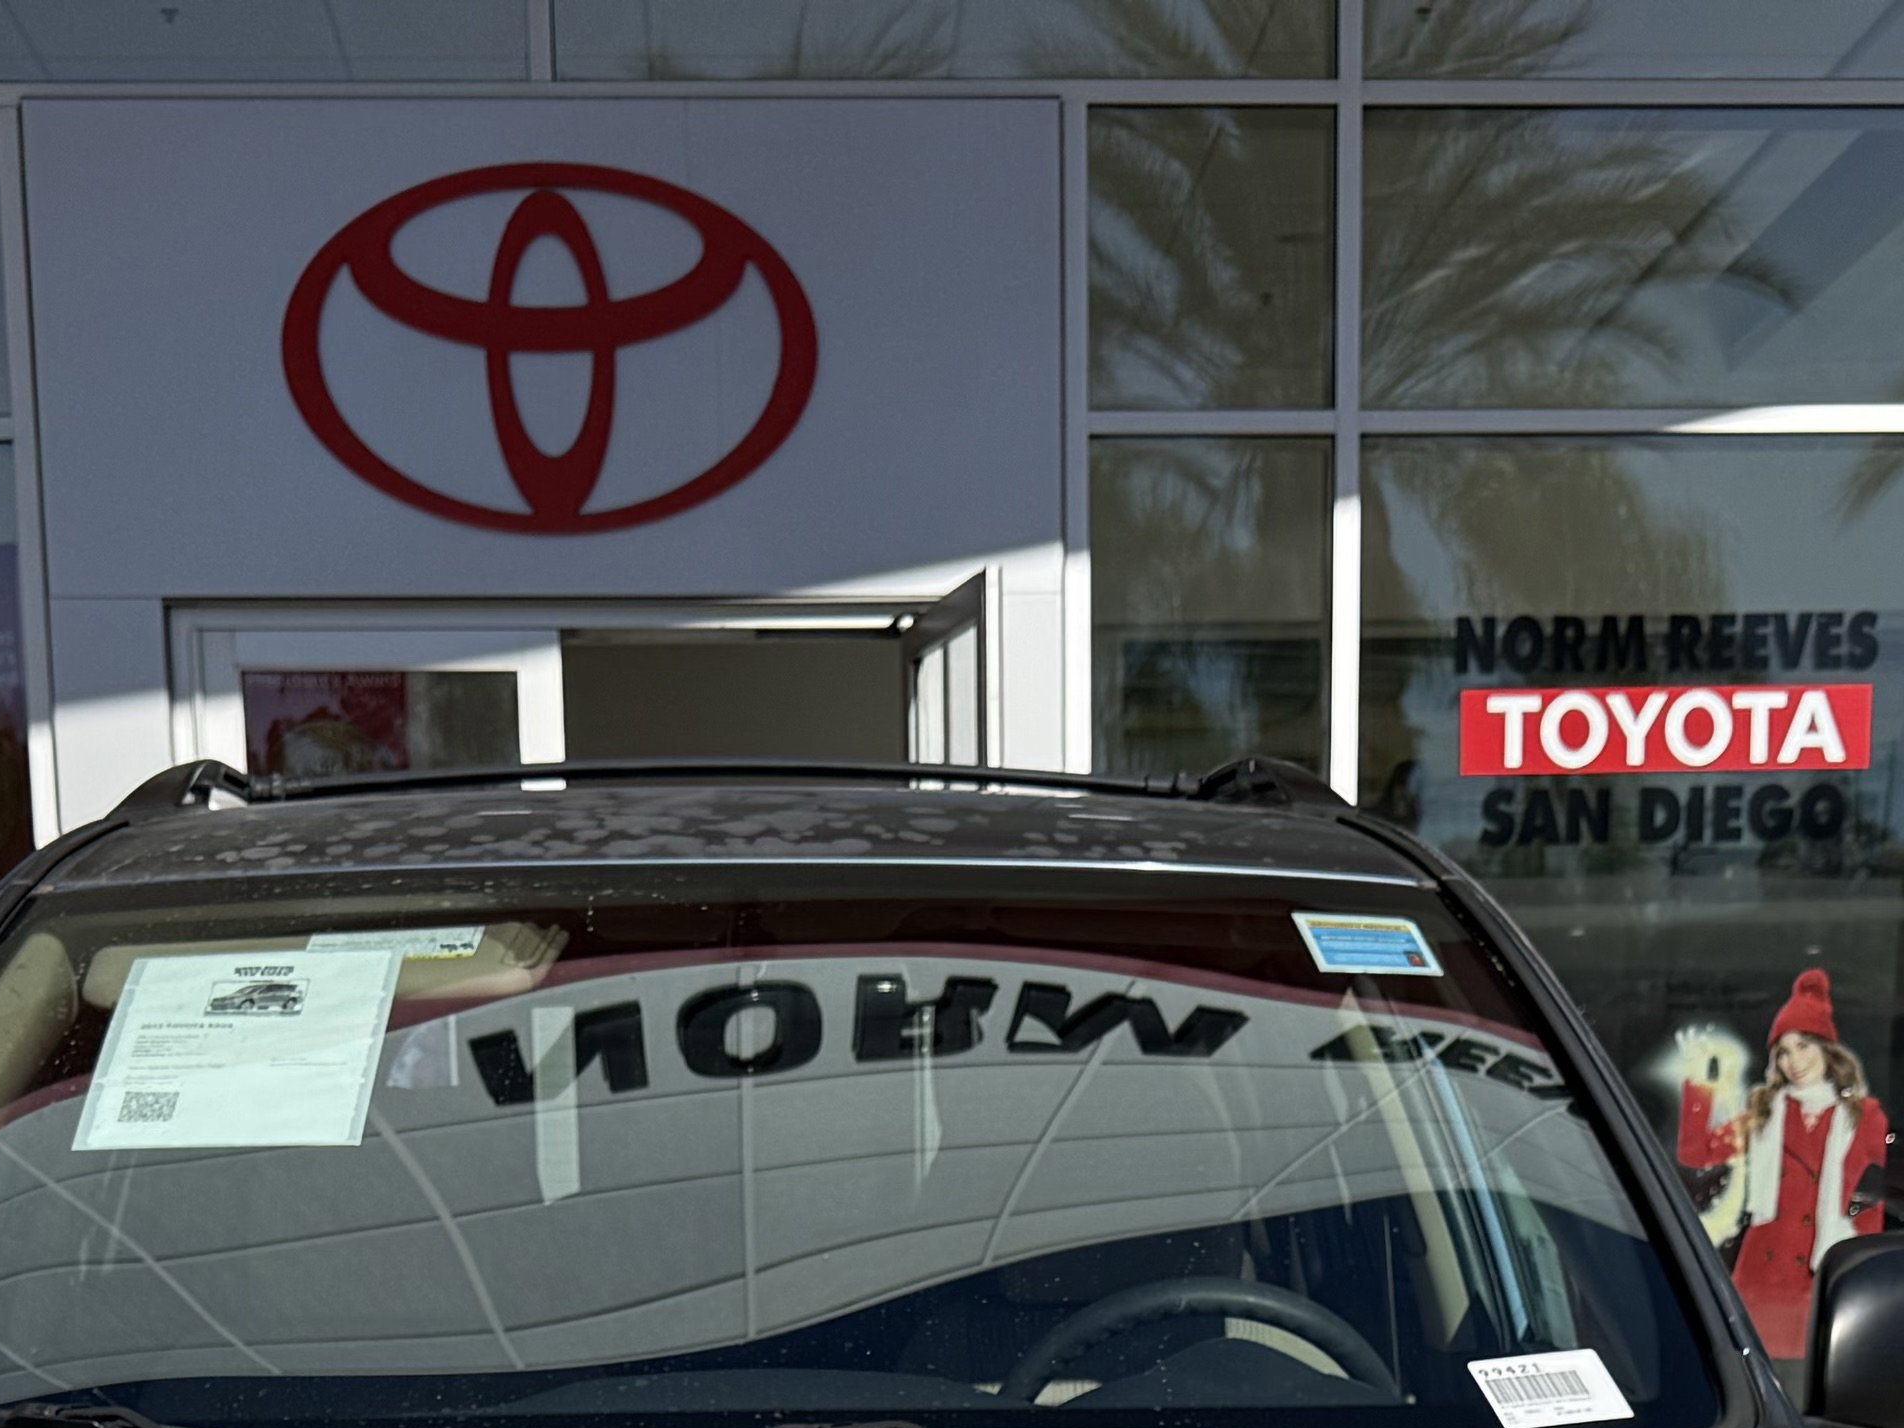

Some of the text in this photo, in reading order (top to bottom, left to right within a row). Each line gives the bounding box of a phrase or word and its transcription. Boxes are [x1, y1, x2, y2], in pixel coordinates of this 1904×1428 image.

[1454, 611, 1880, 676] NORM REEVES
[1486, 688, 1846, 769] TOYOTA
[1478, 783, 1848, 848] SAN DIEGO
